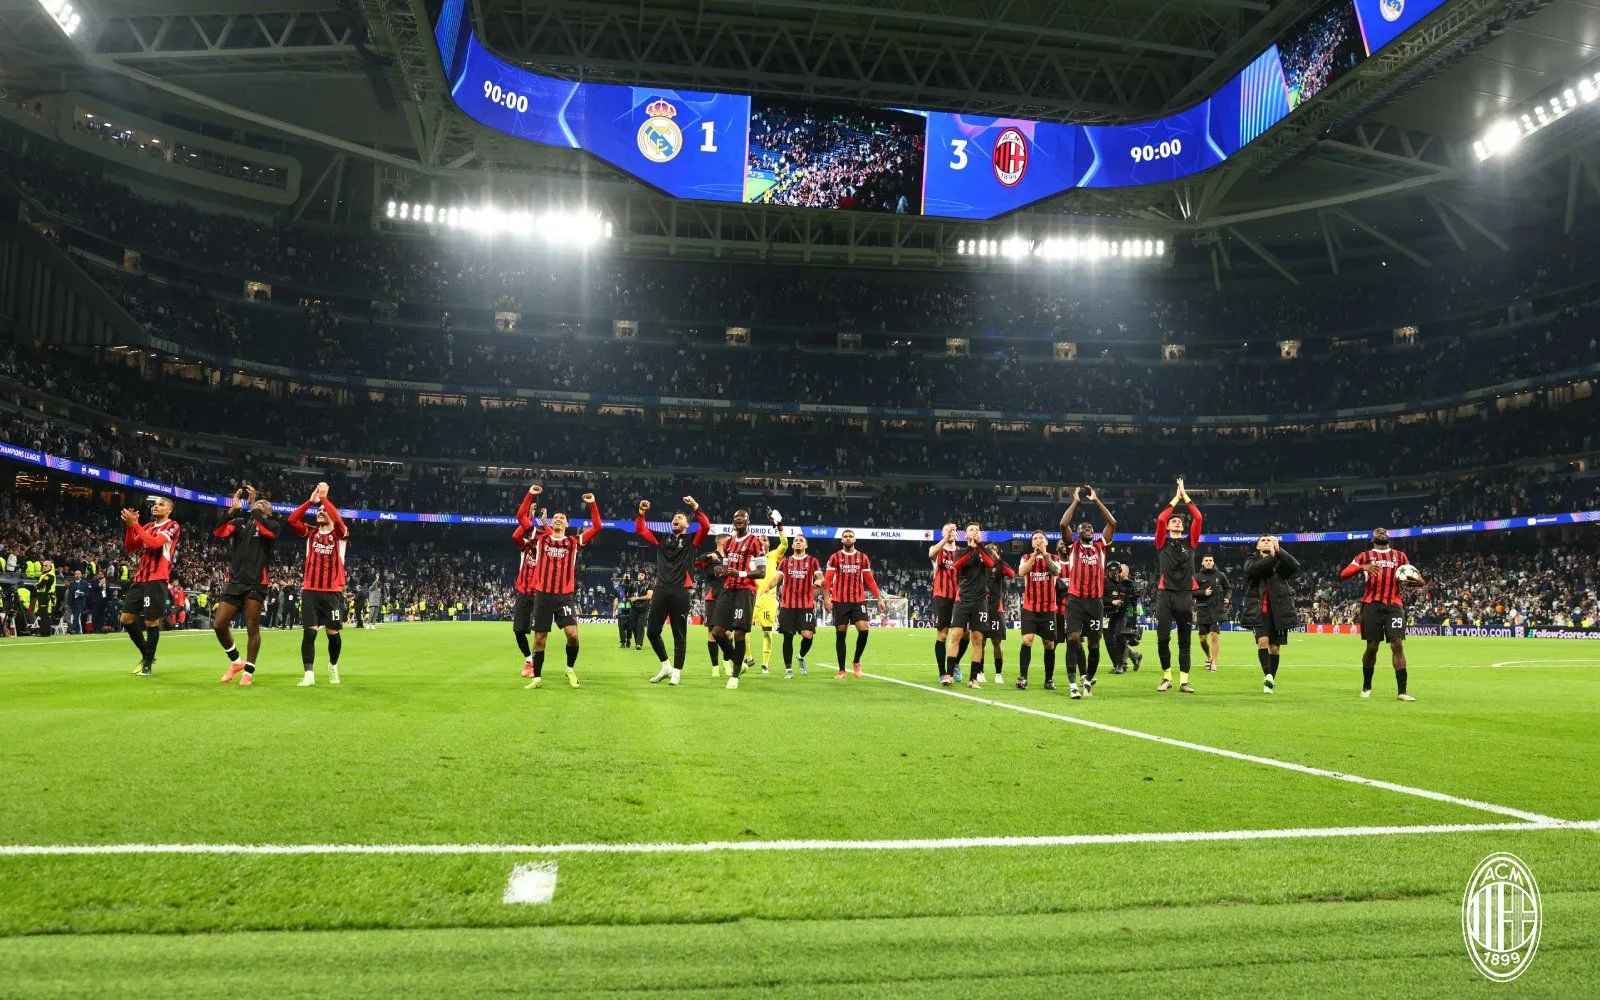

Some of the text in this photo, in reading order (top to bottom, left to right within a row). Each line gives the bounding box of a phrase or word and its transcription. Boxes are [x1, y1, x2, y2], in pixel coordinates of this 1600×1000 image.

[483, 80, 529, 113] 90:00
[700, 121, 718, 152] 1
[1002, 132, 1021, 143] ACM
[950, 139, 968, 170] 3
[1130, 139, 1182, 163] 90:00
[24, 451, 41, 461] LEAGUE
[331, 609, 340, 621] 19
[562, 605, 572, 616] 14
[763, 611, 770, 620] 16
[576, 616, 619, 624] lowScores
[805, 613, 813, 622] 17
[979, 612, 988, 622] 73
[1391, 617, 1403, 628] 29
[991, 621, 1000, 630] 21
[1049, 620, 1055, 630] 2
[1090, 620, 1100, 631] 23
[1405, 626, 1438, 635] AIRWAYS
[1456, 626, 1511, 637] crypto.com
